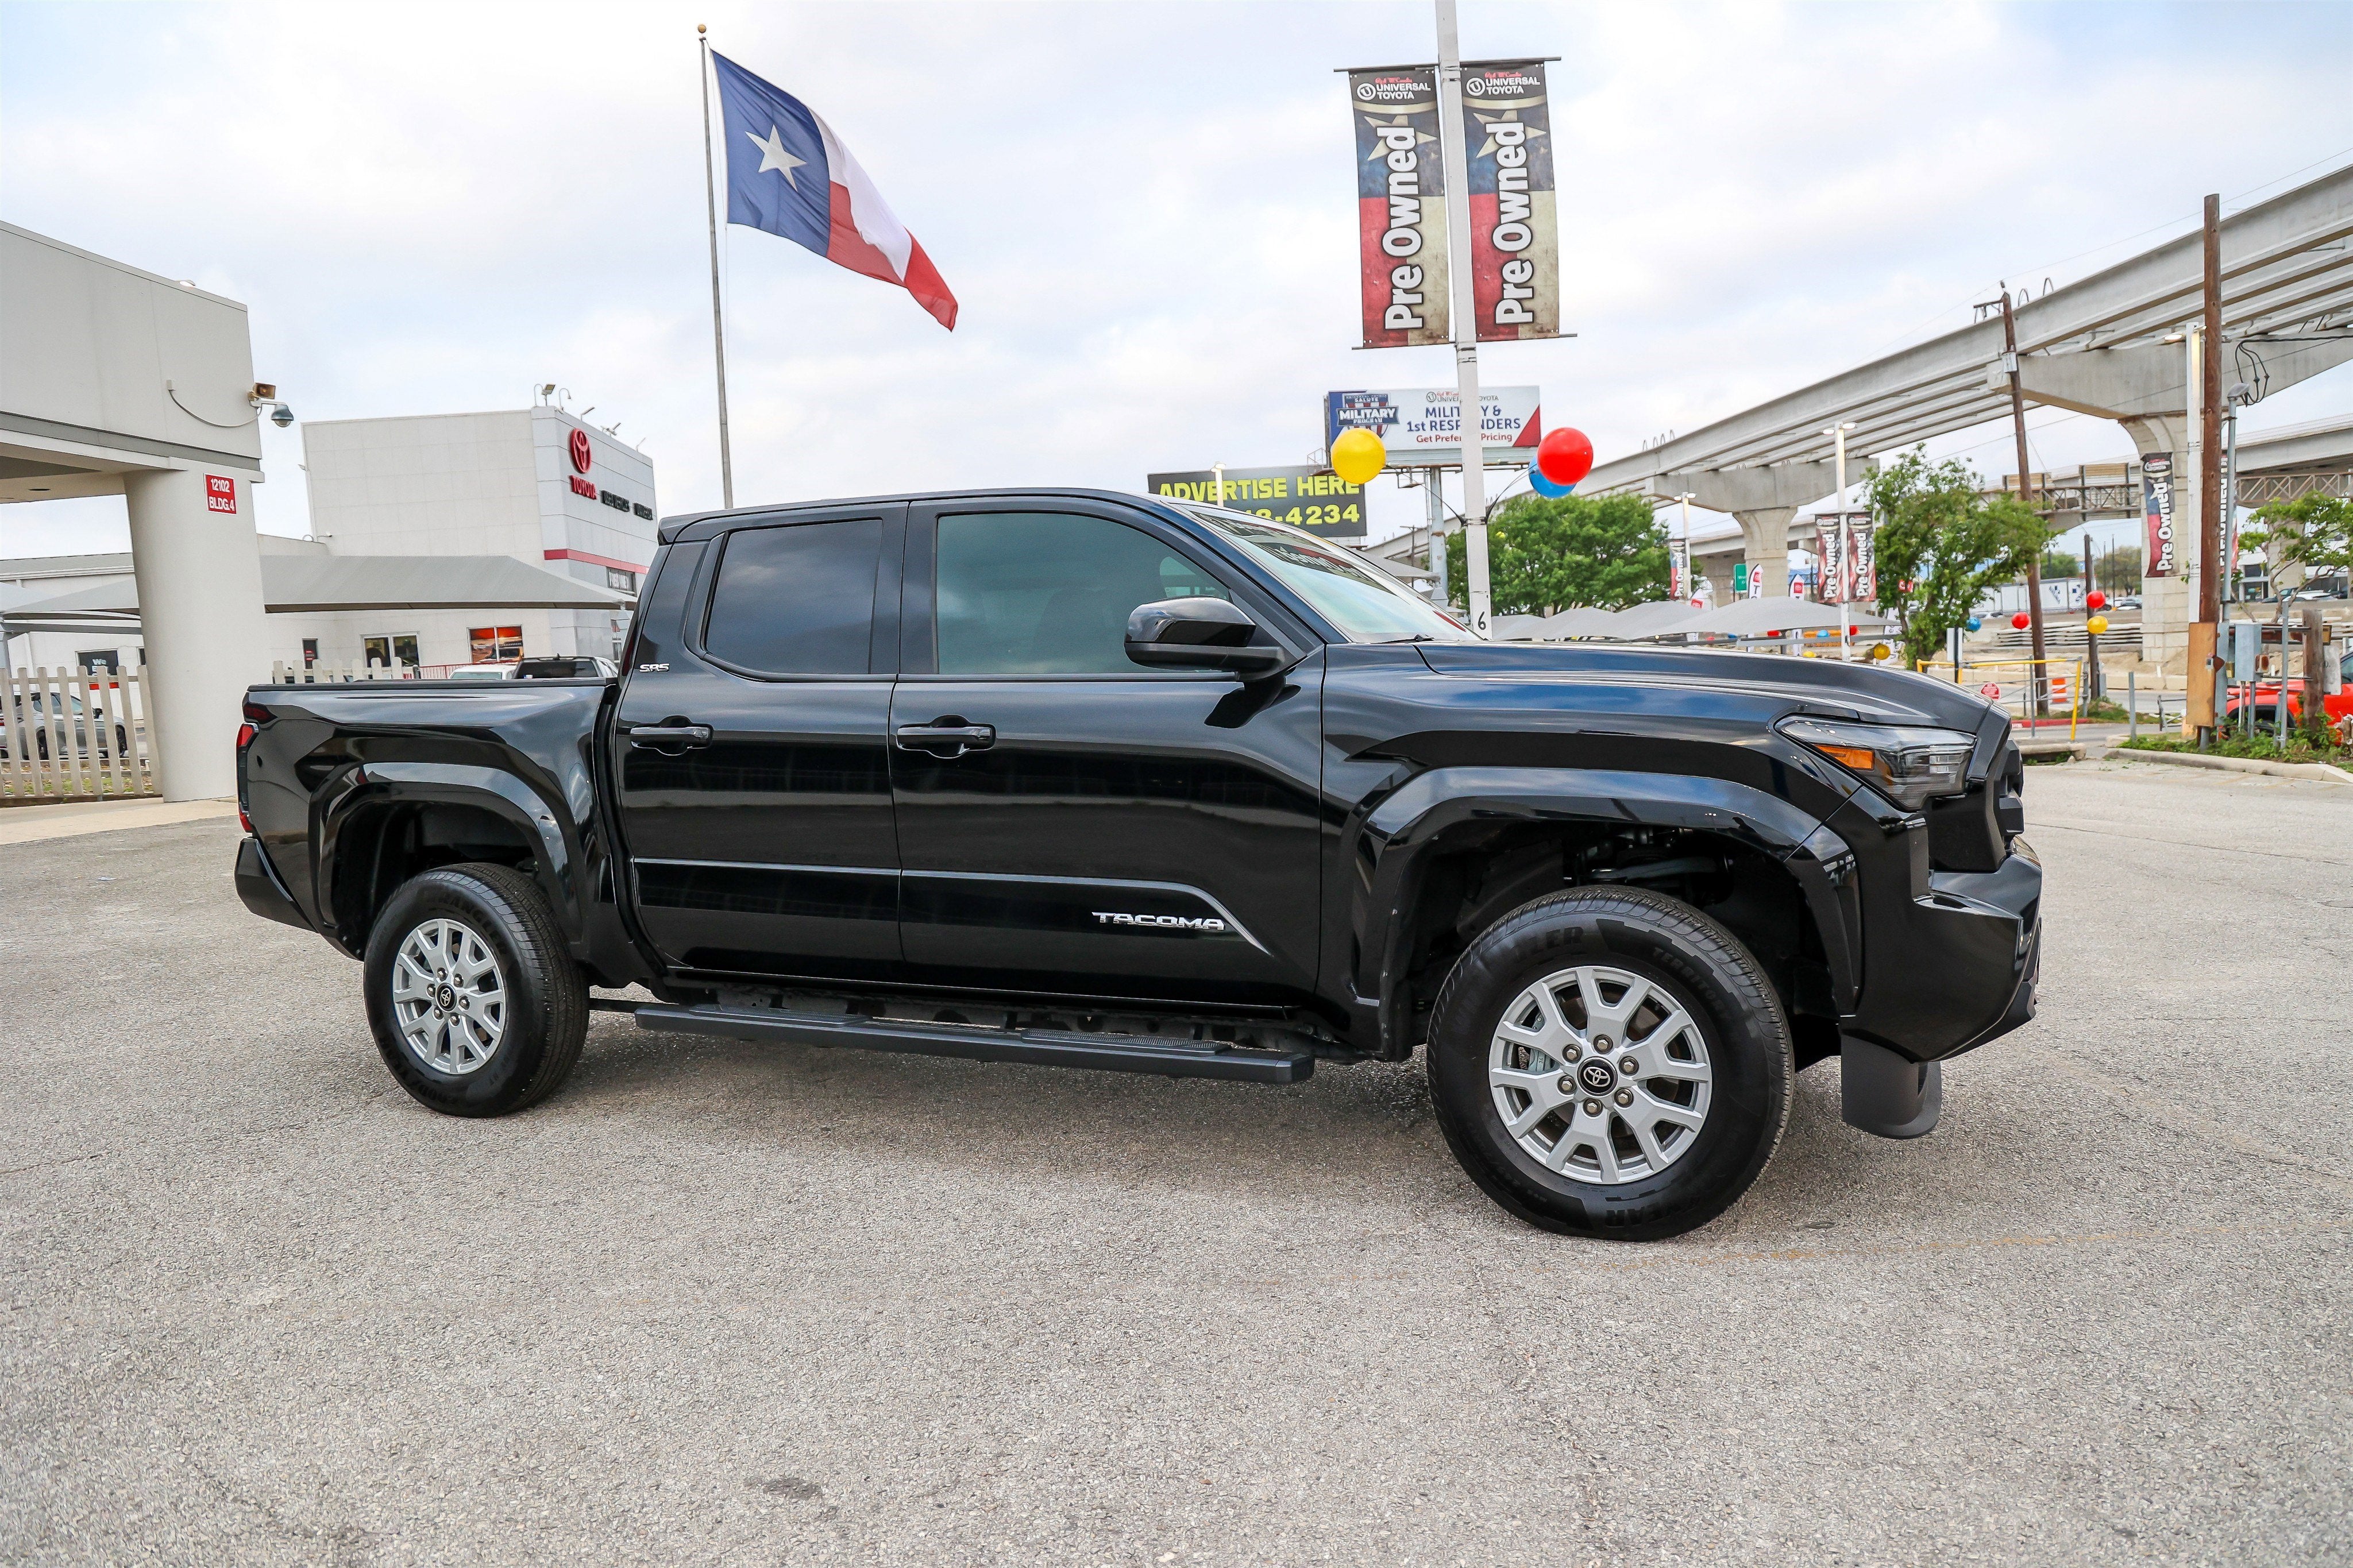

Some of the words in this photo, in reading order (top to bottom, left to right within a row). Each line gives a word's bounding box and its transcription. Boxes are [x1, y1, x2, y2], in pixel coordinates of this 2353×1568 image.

[1376, 83, 1431, 91] UNIVERSAL
[1486, 77, 1540, 86] UNIVERSAL
[1486, 86, 1524, 95] TOYOTA
[1377, 91, 1415, 99] TOYOTA
[1376, 126, 1422, 257] Owned
[1486, 122, 1533, 252] Owned
[1384, 264, 1424, 330] Pre
[1495, 260, 1534, 324] Pre
[1340, 408, 1395, 420] MILITARY
[1426, 405, 1489, 418] MILITY
[1493, 405, 1502, 416] &
[1407, 420, 1426, 432] 1st
[1481, 432, 1512, 442] Pricing
[210, 478, 231, 493] 12102
[570, 476, 596, 500] TOYOTA
[1160, 477, 1287, 502] ADVERTISE
[1297, 476, 1360, 496] HERE
[230, 499, 235, 511] 4
[2153, 482, 2173, 540] Owned
[1822, 534, 1837, 576] Owned
[1854, 532, 1868, 575] Owned
[2155, 542, 2173, 571] Pre
[1675, 552, 1684, 581] Owned
[1674, 582, 1684, 597] Pre
[1824, 577, 1837, 598] Pre
[1857, 576, 1869, 597] Pre
[1478, 611, 1486, 630] 6
[639, 663, 670, 672] SR5
[1091, 912, 1225, 930] TACOMA
